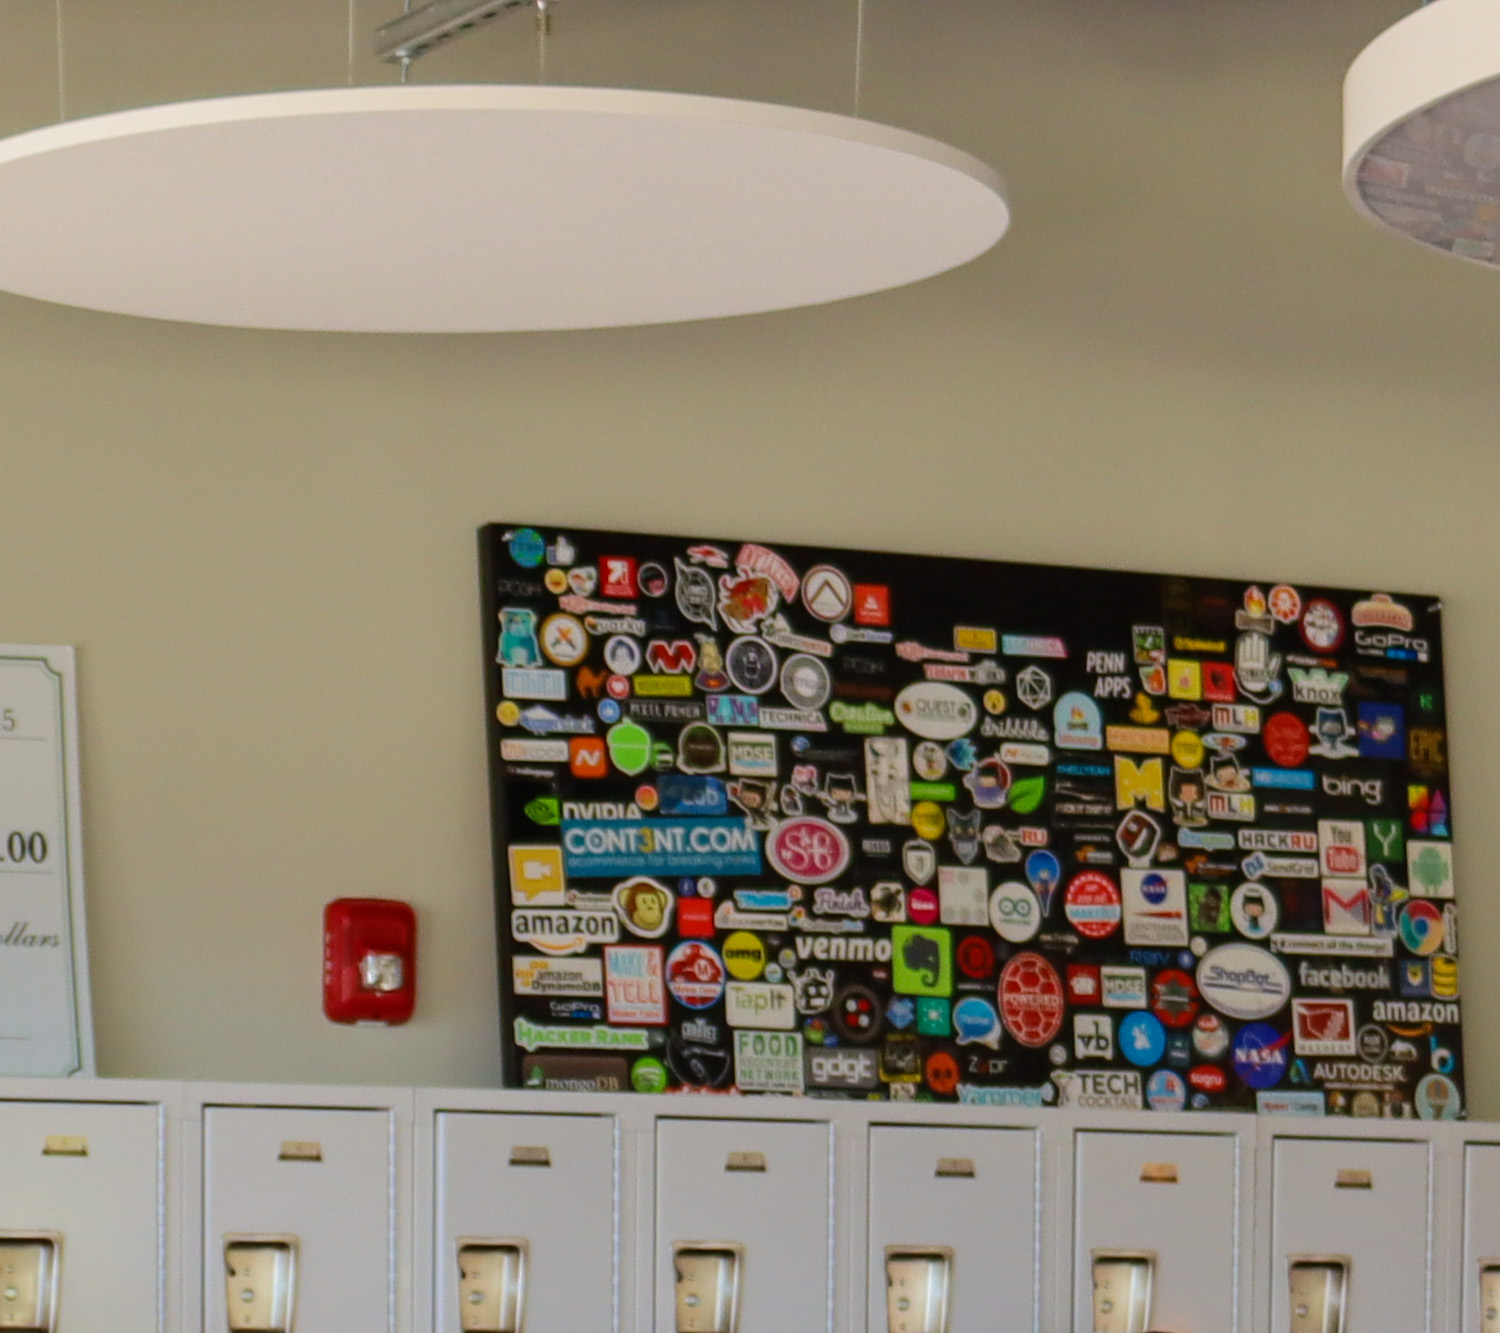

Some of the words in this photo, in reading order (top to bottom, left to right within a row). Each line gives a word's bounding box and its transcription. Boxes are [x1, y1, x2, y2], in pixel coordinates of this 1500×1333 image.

[1355, 630, 1428, 651] GoPro
[1086, 651, 1124, 673] PENN
[1094, 676, 1132, 699] APPS
[1322, 774, 1382, 805] bing
[565, 826, 758, 854] CONT3NT.COM
[1241, 832, 1315, 850] HACKRU
[515, 912, 616, 936] amazon
[794, 935, 892, 962] venmo
[537, 970, 584, 982] amazon
[1299, 961, 1391, 989] facebook
[1373, 1000, 1460, 1024] amazon
[738, 1033, 799, 1056] FOOD
[1234, 1048, 1284, 1065] NASA
[812, 1052, 873, 1085] gdgt
[1313, 1062, 1408, 1083] AUTODESK
[1080, 1073, 1139, 1096] TECH
